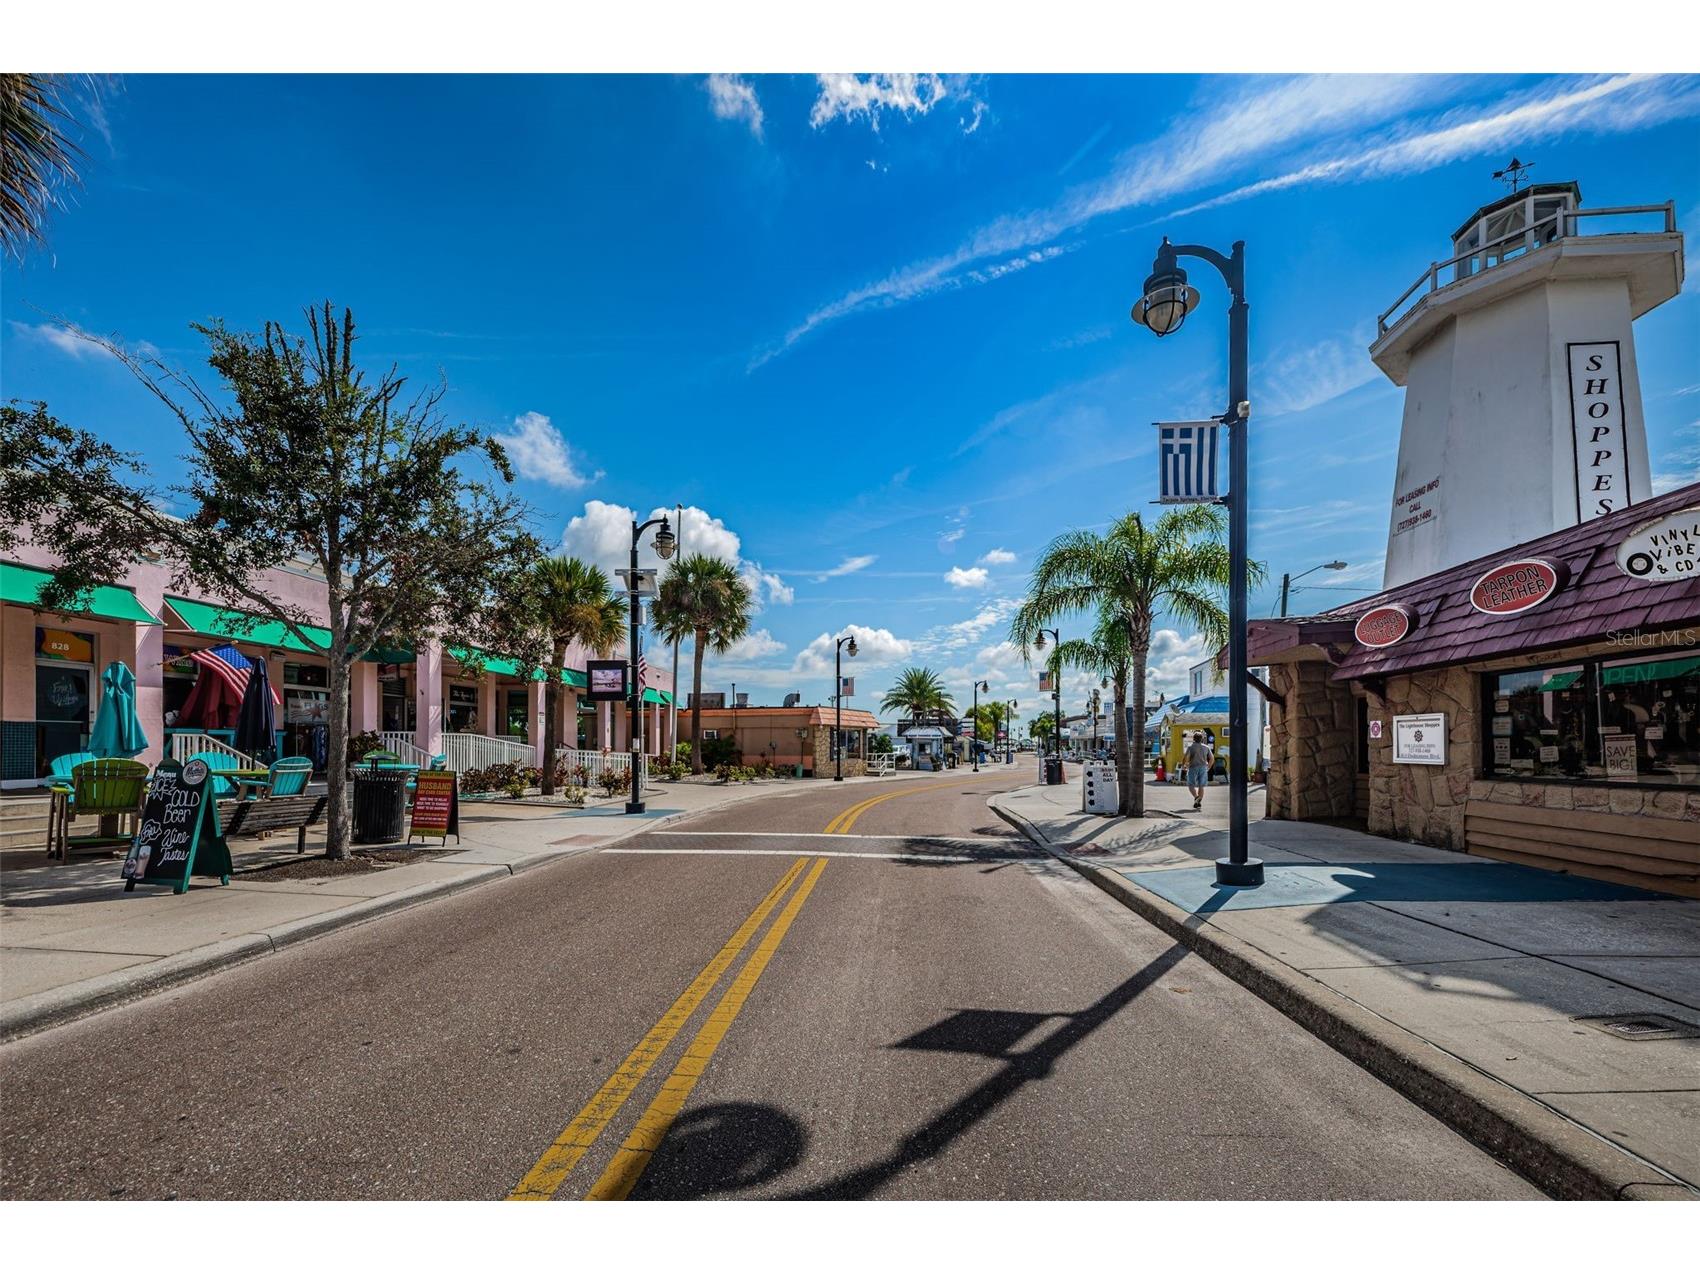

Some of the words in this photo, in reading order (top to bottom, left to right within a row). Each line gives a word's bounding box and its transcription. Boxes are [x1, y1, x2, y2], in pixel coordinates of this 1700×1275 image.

[1584, 354, 1613, 515] SHOPPES
[1396, 496, 1405, 507] FOR
[1405, 486, 1426, 503] LEASING
[1427, 479, 1440, 493] INFO
[1409, 501, 1421, 513] CALL
[1650, 524, 1700, 546] VINYL
[1657, 564, 1669, 574] &
[1480, 565, 1540, 594] TARPON
[1483, 579, 1547, 609] LEATHER
[1360, 612, 1402, 633] LUGGAGE
[1365, 624, 1401, 643] OUTLET
[51, 642, 70, 651] 828
[1606, 746, 1635, 758] SAVE
[155, 769, 177, 778] Menu
[1609, 758, 1634, 770] BIG!
[418, 782, 452, 790] HUSBAND
[171, 789, 200, 807] COLD
[163, 805, 191, 824] Beer
[161, 829, 191, 848] Wine
[157, 847, 189, 867] Tastes
